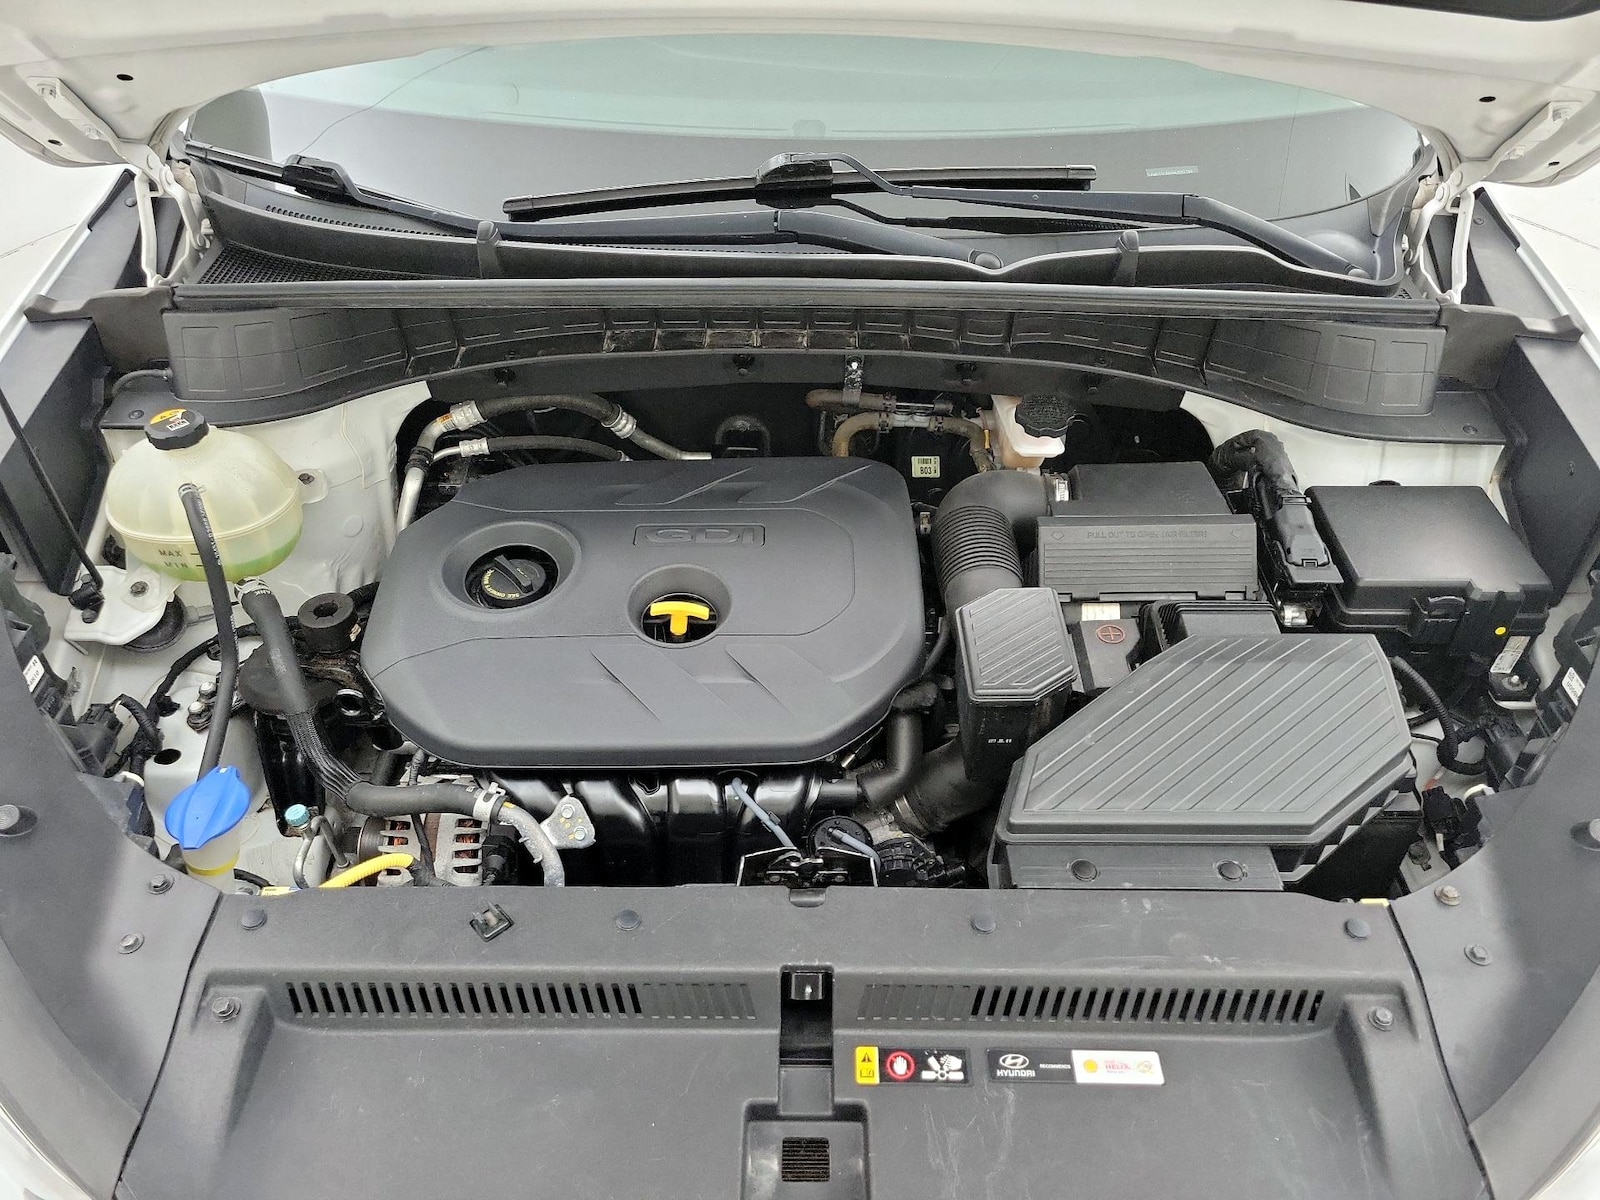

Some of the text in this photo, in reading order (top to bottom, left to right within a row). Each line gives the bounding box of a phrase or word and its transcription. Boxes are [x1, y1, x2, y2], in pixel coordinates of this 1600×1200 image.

[645, 528, 755, 545] GDI
[1087, 530, 1107, 539] PULL
[1108, 530, 1123, 538] OUT
[1125, 530, 1136, 538] TO
[158, 549, 182, 557] MAX
[164, 561, 189, 569] MIN
[997, 1069, 1036, 1077] HYUNDAI
